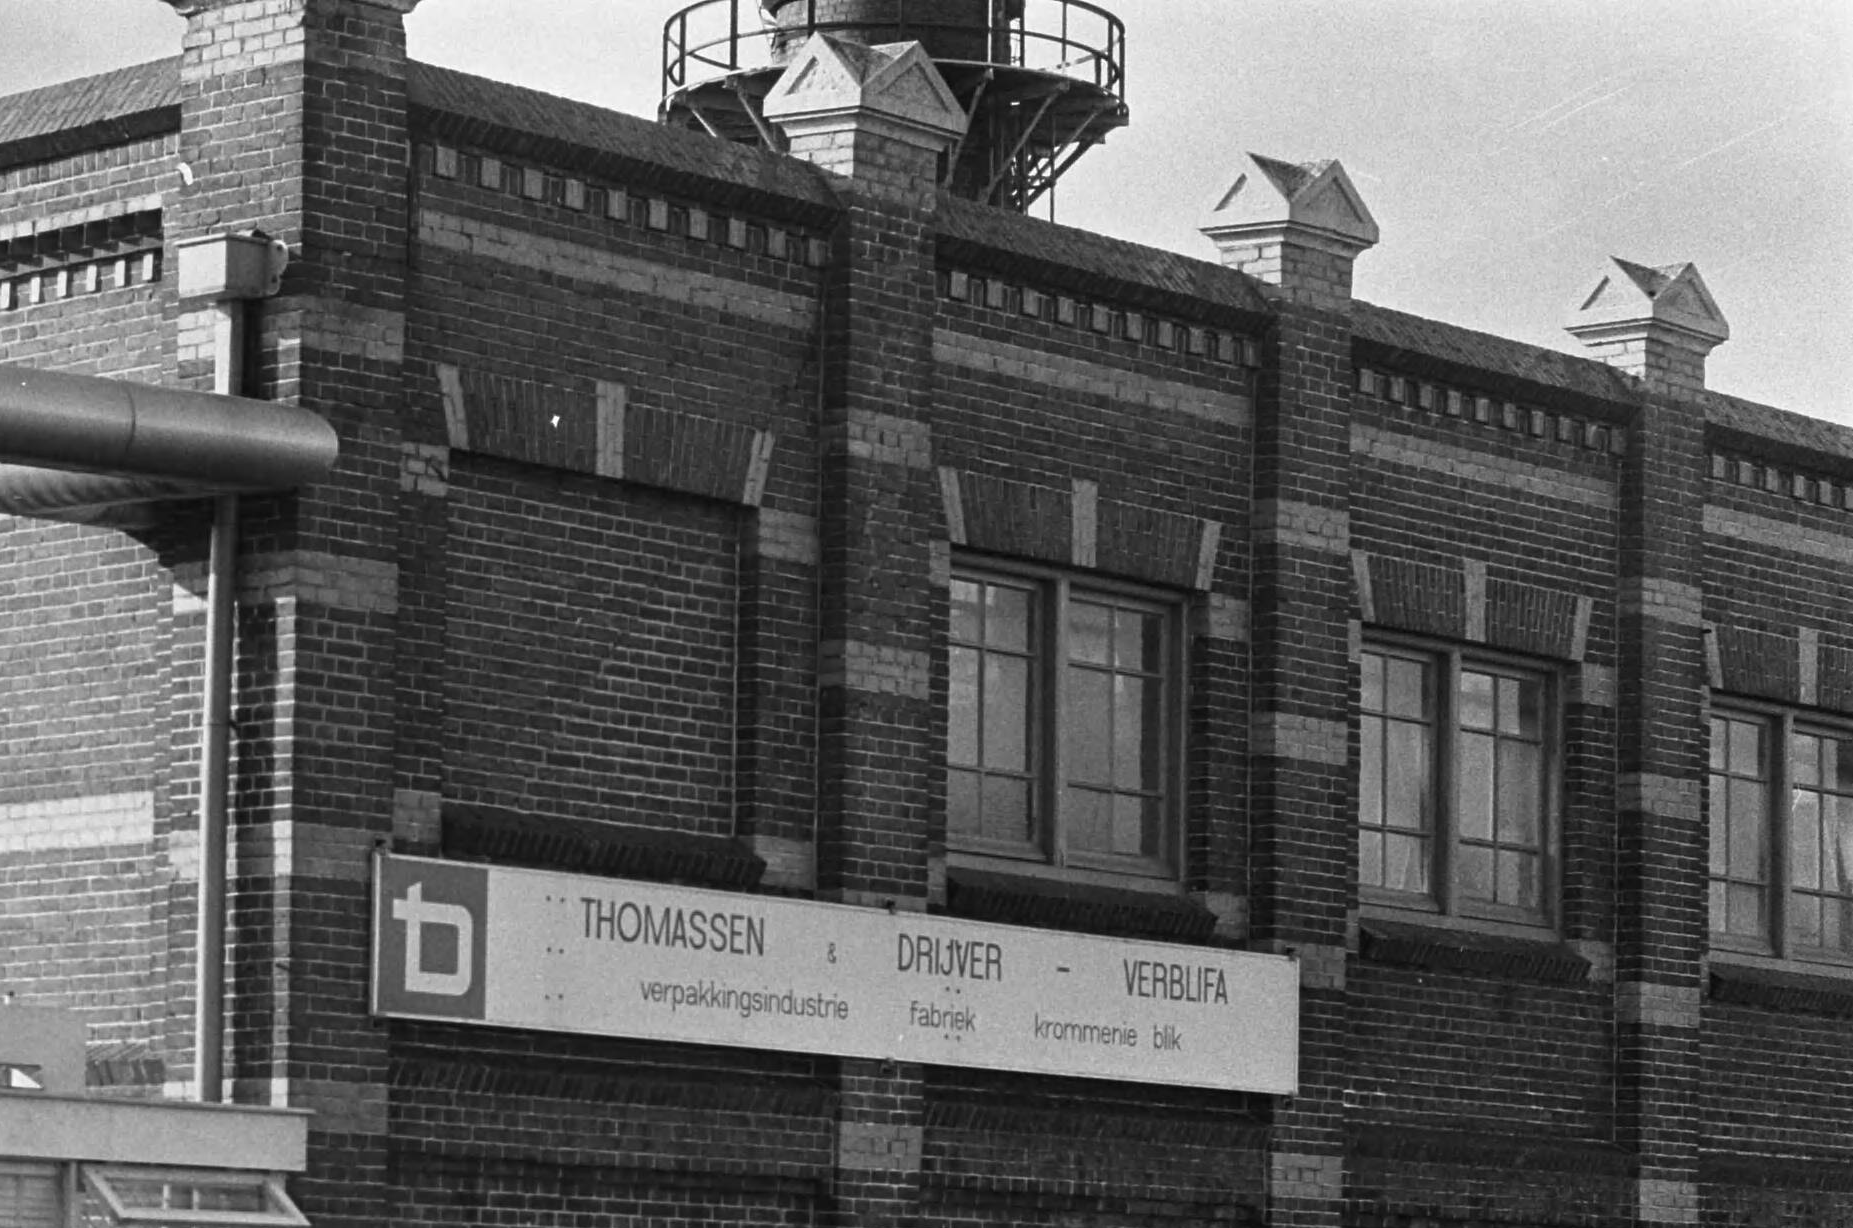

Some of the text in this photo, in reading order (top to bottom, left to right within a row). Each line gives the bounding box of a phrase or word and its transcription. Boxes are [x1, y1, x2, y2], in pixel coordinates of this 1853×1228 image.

[580, 896, 765, 956] THOMASSEN
[827, 941, 837, 964] &
[897, 932, 1002, 981] DRIJVER
[1123, 958, 1228, 1005] VERBLIFA
[640, 978, 1182, 1051] verpakkingsindustrie fabriek krommenie blik
